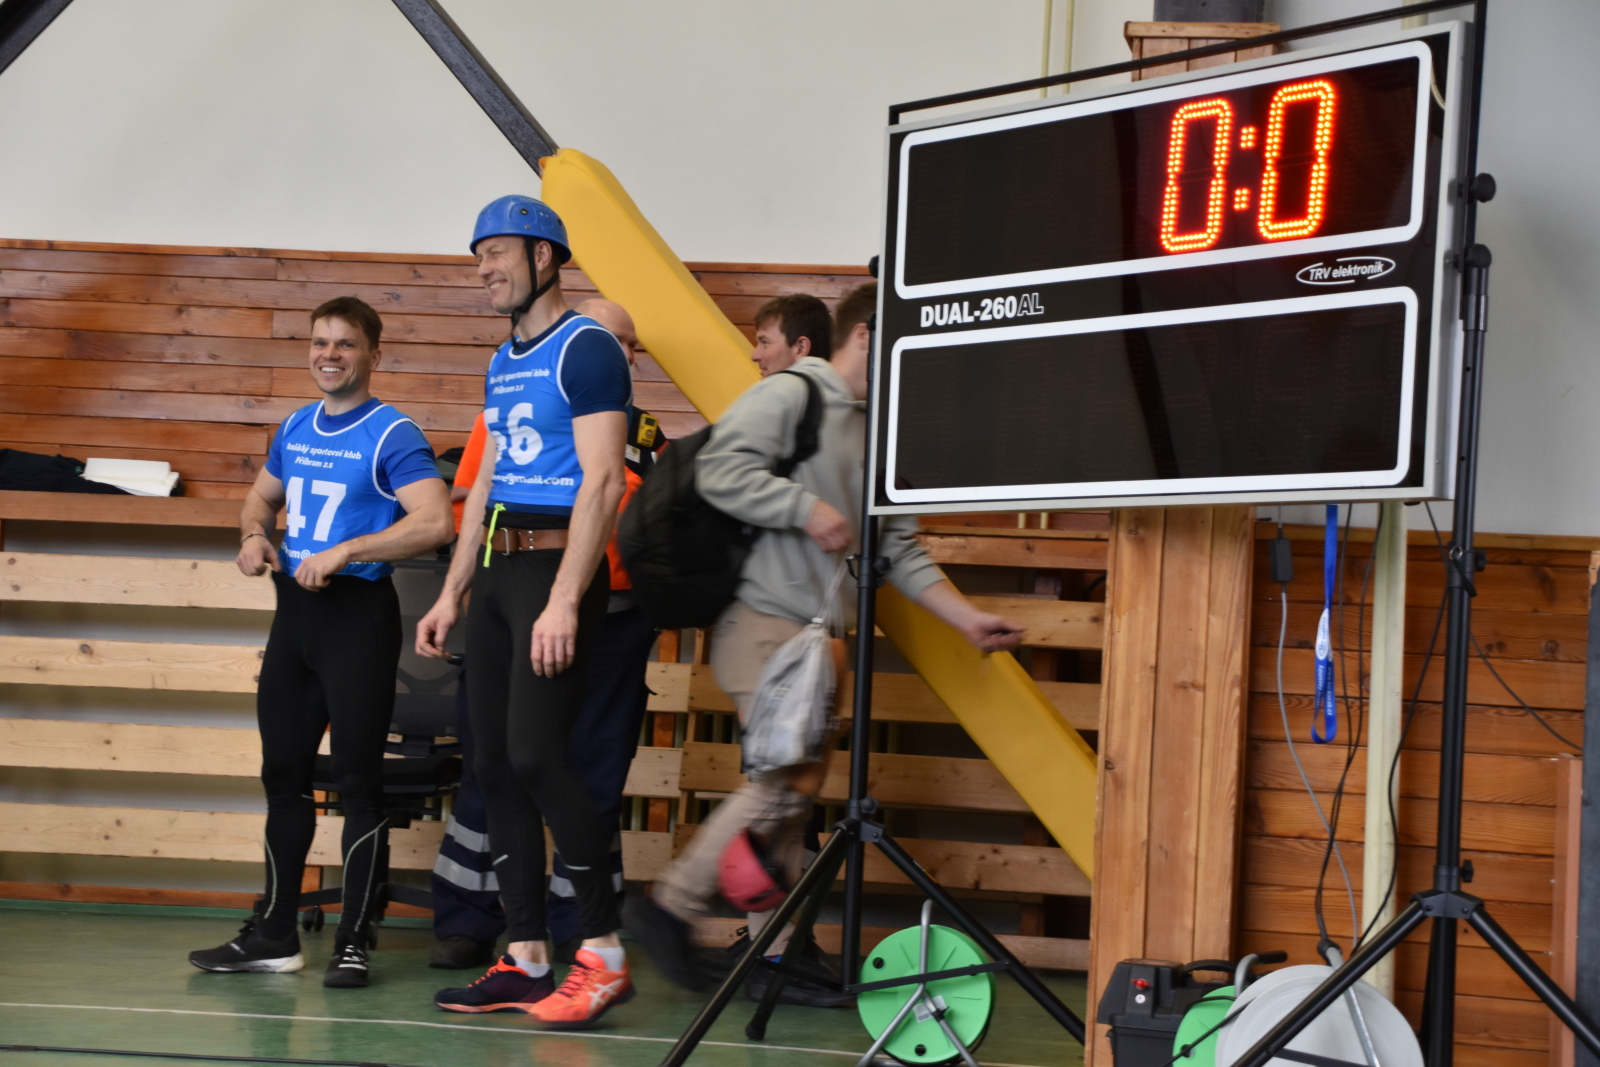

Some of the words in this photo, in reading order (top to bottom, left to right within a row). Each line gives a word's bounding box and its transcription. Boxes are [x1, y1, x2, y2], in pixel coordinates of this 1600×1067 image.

[1161, 80, 1335, 252] 0:0
[1309, 267, 1332, 281] TRV
[1331, 261, 1384, 278] elektronik
[920, 292, 1045, 328] DUAL-260AL
[295, 456, 322, 468] Příbram
[310, 447, 344, 456] sportovní
[344, 450, 362, 460] klub
[286, 475, 347, 542] 47
